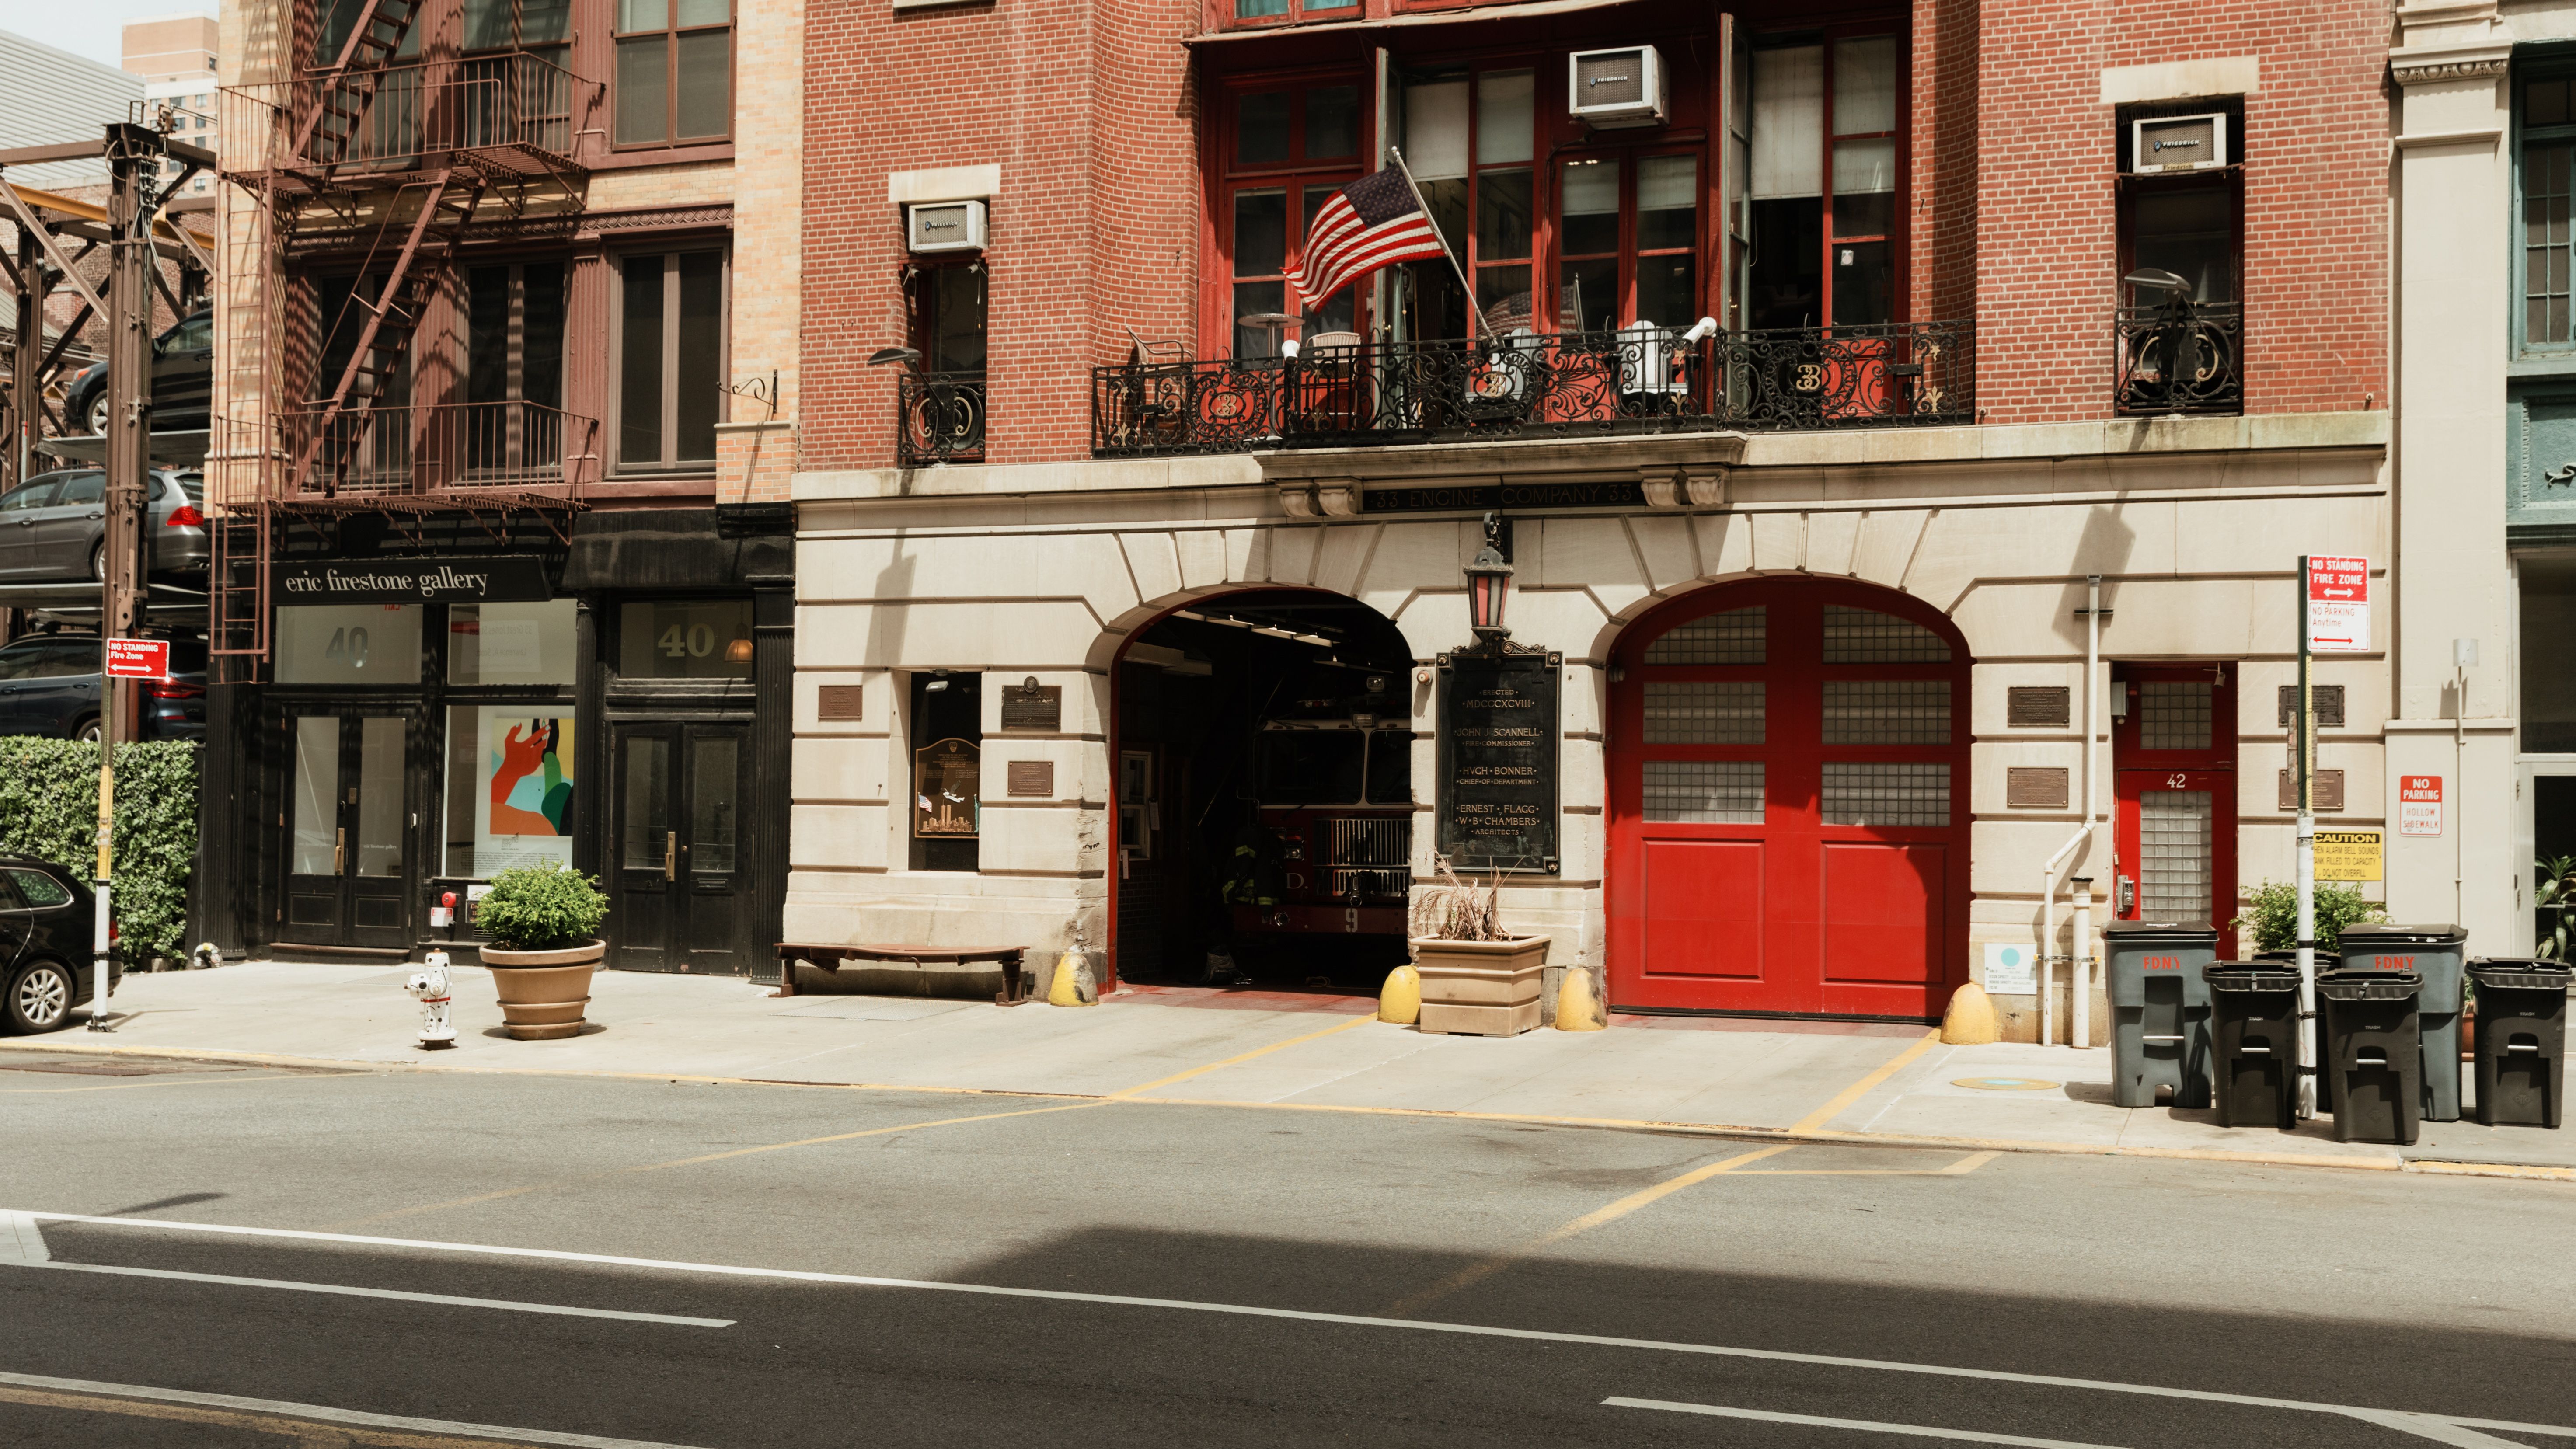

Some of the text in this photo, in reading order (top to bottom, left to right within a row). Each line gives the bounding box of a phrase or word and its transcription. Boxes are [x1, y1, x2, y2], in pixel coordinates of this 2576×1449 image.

[1377, 484, 1631, 507] 33 ENGINE COMPANY 33
[2312, 560, 2364, 571] NO STANDING
[286, 566, 488, 596] eric firestone gallery
[2314, 574, 2363, 585] FIRE ZONE
[2312, 607, 2355, 616] NO PARKING
[2313, 618, 2342, 628] Anytime
[658, 622, 715, 658] 40
[123, 644, 158, 652] STANDING
[325, 627, 368, 668] 40
[110, 651, 144, 660] Fire Zone
[1466, 700, 1530, 708] MDCCCXCVIII
[1457, 728, 1481, 736] JOHN
[1494, 728, 1540, 736] SCANNELL
[1463, 767, 1533, 775] HVGH BONNER
[2166, 773, 2186, 788] 42
[2413, 778, 2430, 789] NO
[2403, 789, 2439, 800] PARKING
[1460, 805, 1535, 813] ERNEST FLAGG
[2406, 808, 2435, 816] HOLLOW
[1473, 817, 1478, 825] B
[1485, 817, 1537, 826] CHAMBERS
[2403, 820, 2439, 829] SIDEWALK
[2313, 834, 2377, 843] CAUTION
[2353, 857, 2376, 866] CAPACITY
[2344, 869, 2366, 877] OVERFILL
[1345, 908, 1358, 933] 9
[2375, 956, 2415, 969] FDNY
